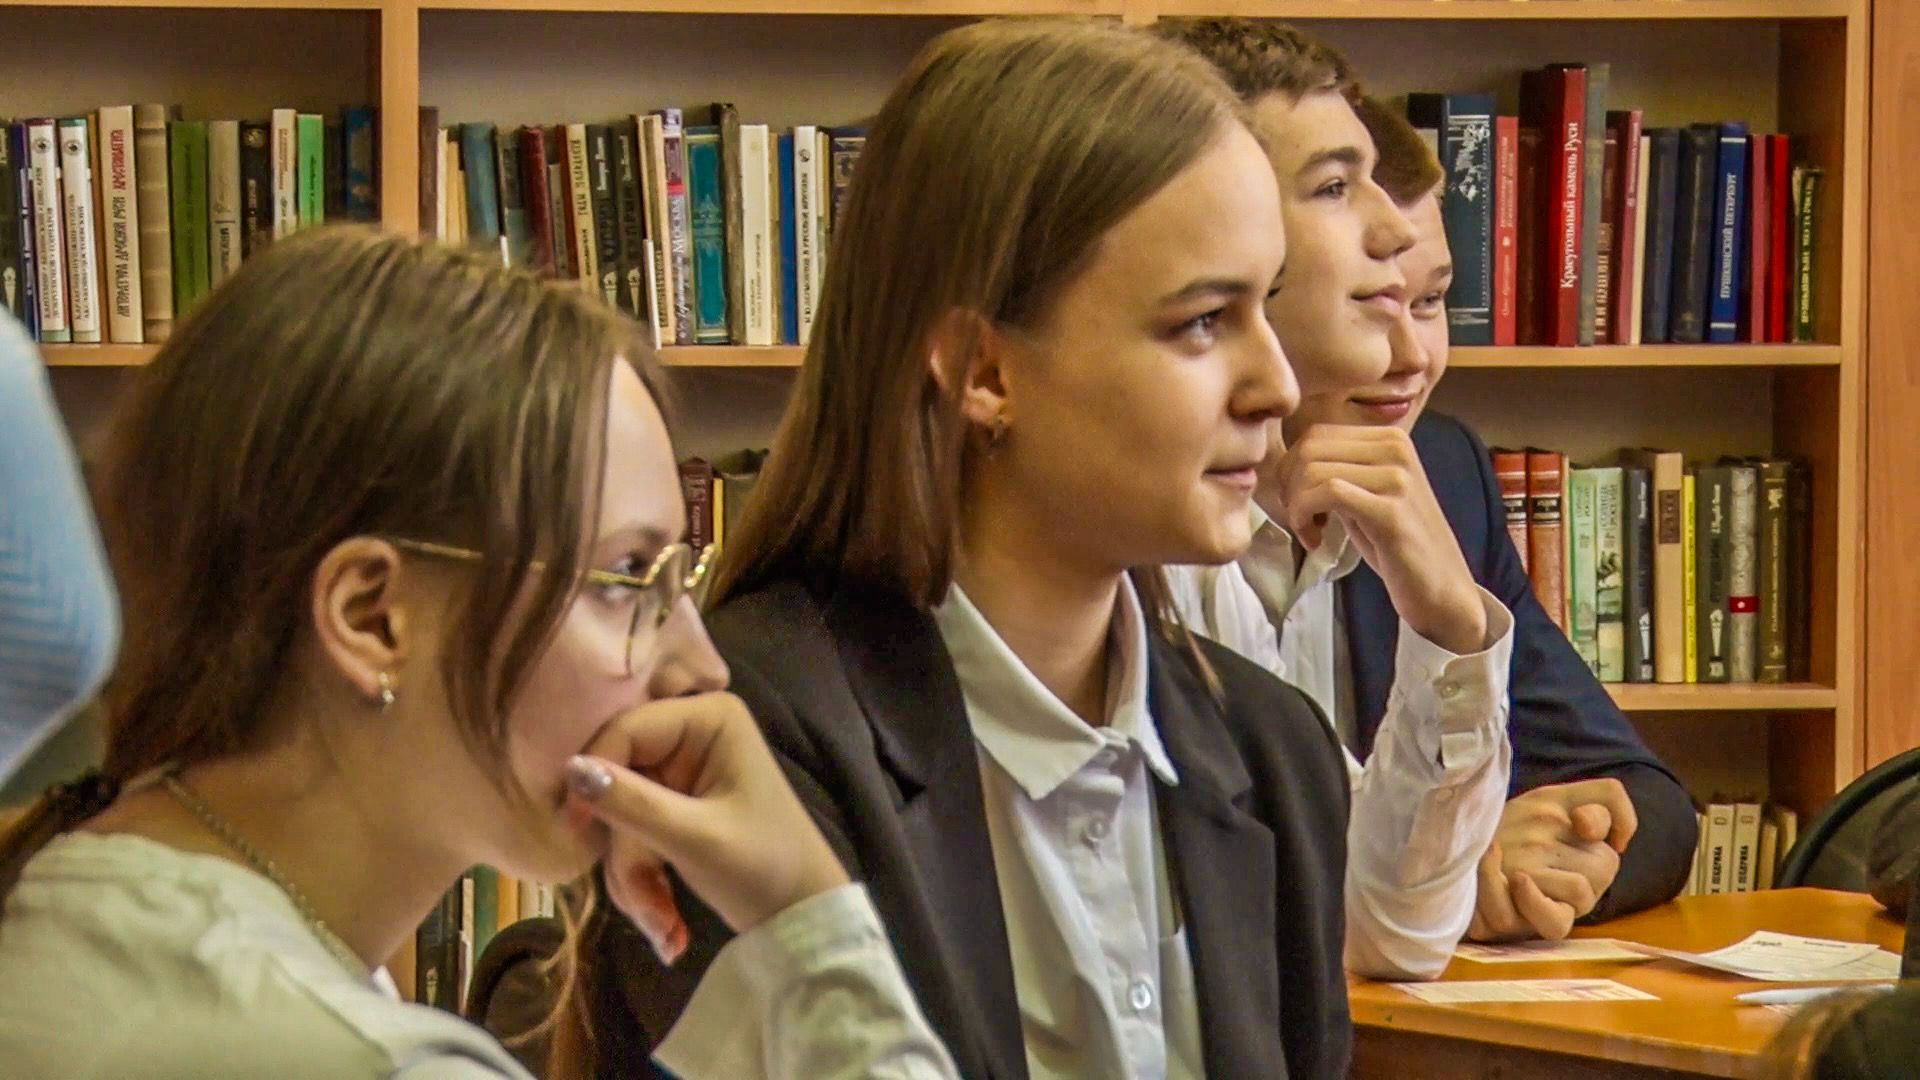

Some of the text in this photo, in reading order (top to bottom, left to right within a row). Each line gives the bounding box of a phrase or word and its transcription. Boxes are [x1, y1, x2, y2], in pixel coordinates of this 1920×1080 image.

[1560, 122, 1582, 289] Краеугольный камень Руси
[1720, 173, 1737, 298] ПУШКИНСКИЙ ПЕТЕРБУРГ
